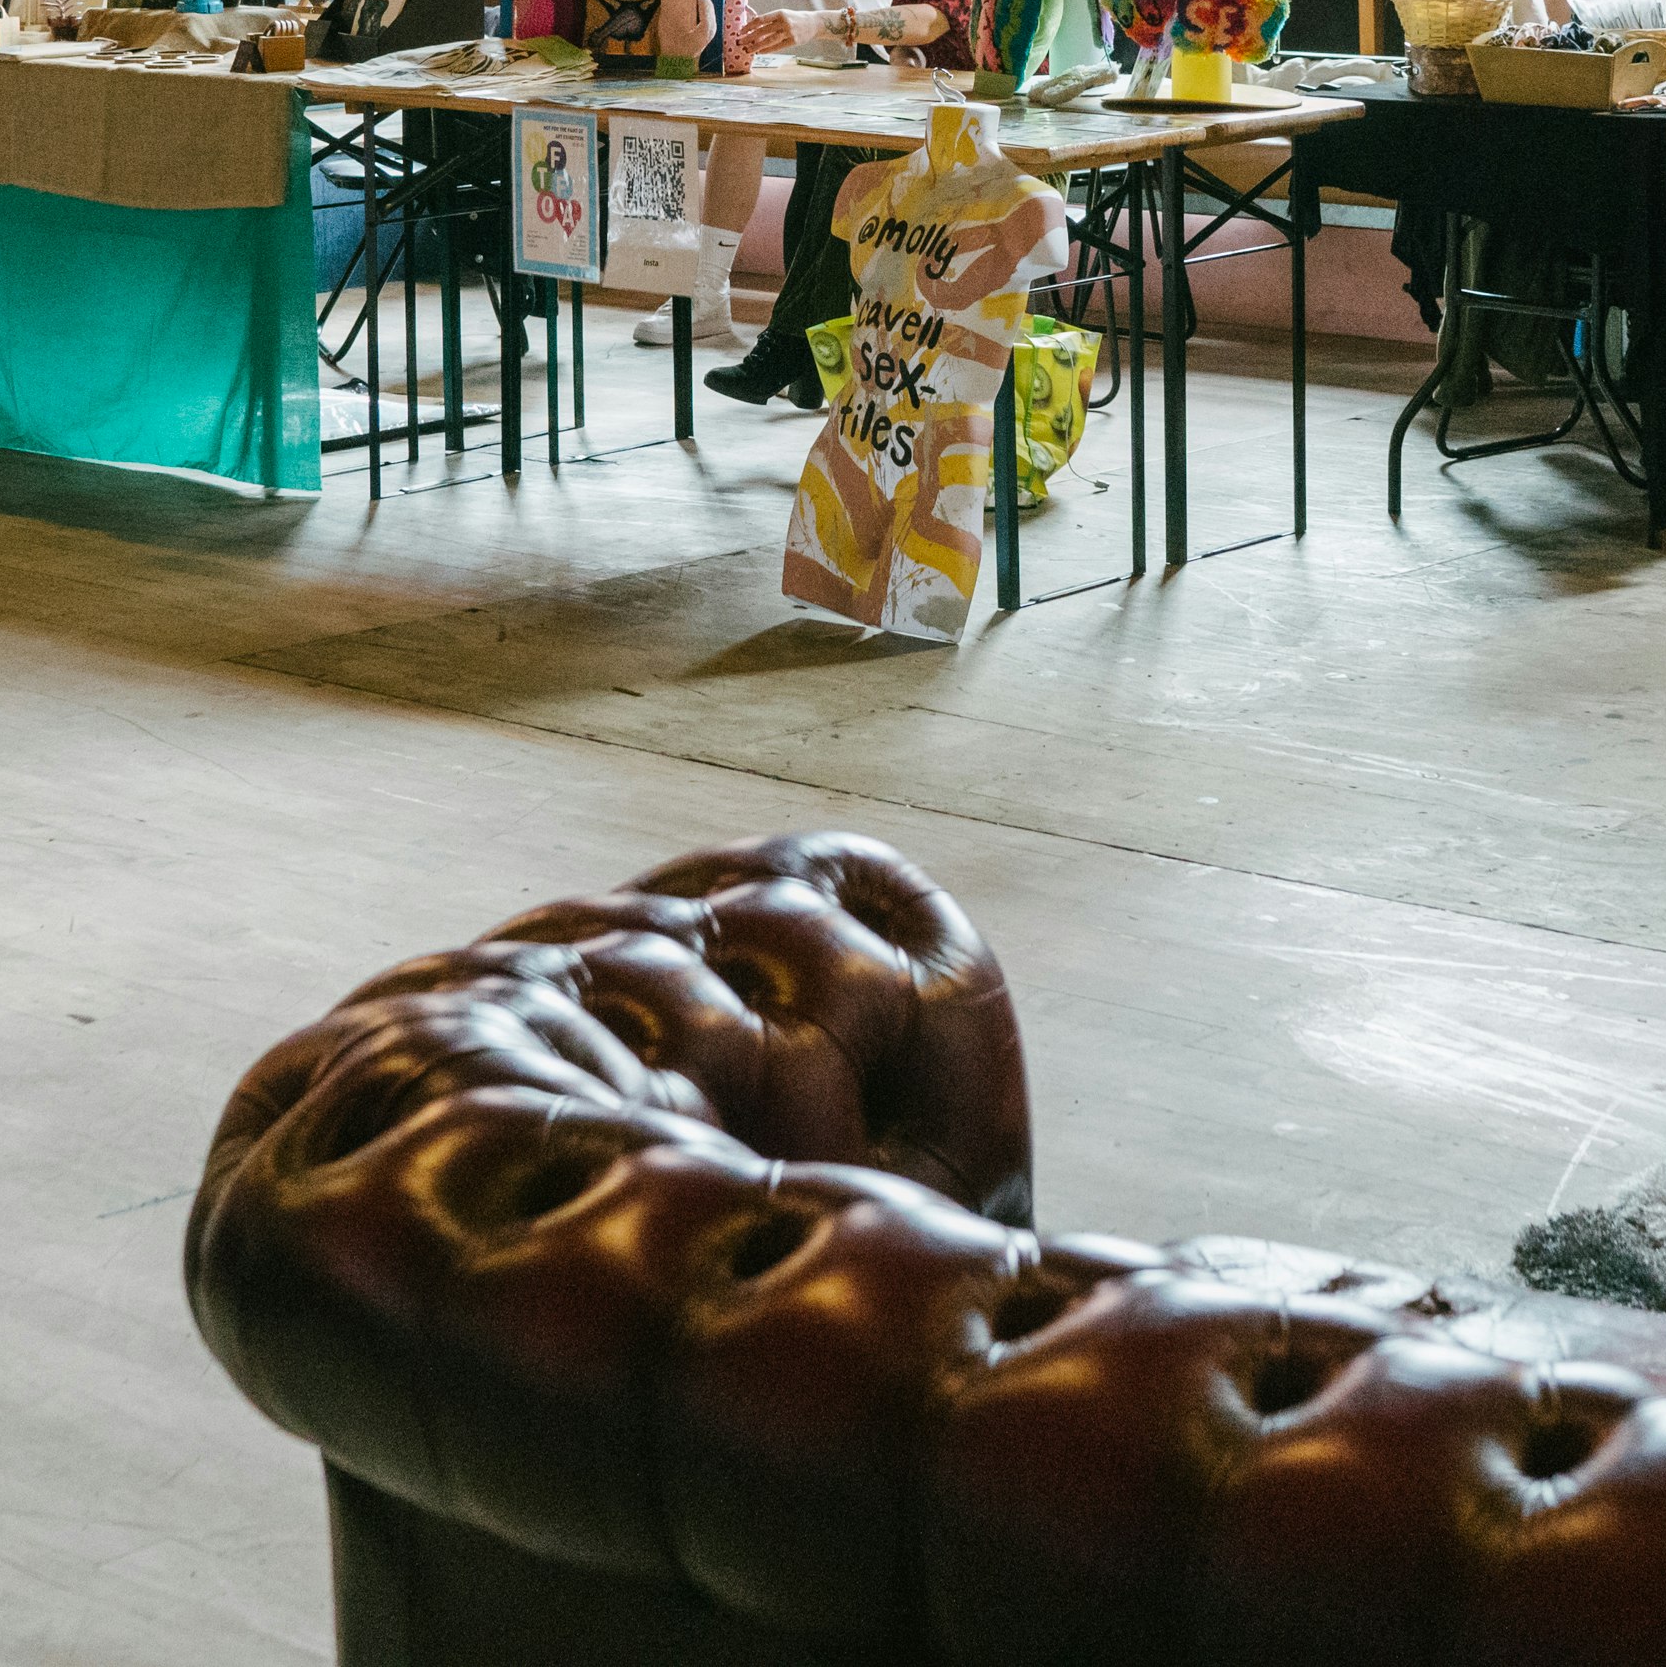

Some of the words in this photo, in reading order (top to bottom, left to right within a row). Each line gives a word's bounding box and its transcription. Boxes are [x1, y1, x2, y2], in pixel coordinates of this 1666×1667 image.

[643, 258, 659, 267] Insta
[857, 215, 959, 280] @molly
[856, 297, 945, 350] cavell
[858, 340, 937, 410] sex-
[839, 393, 915, 468] tiles
